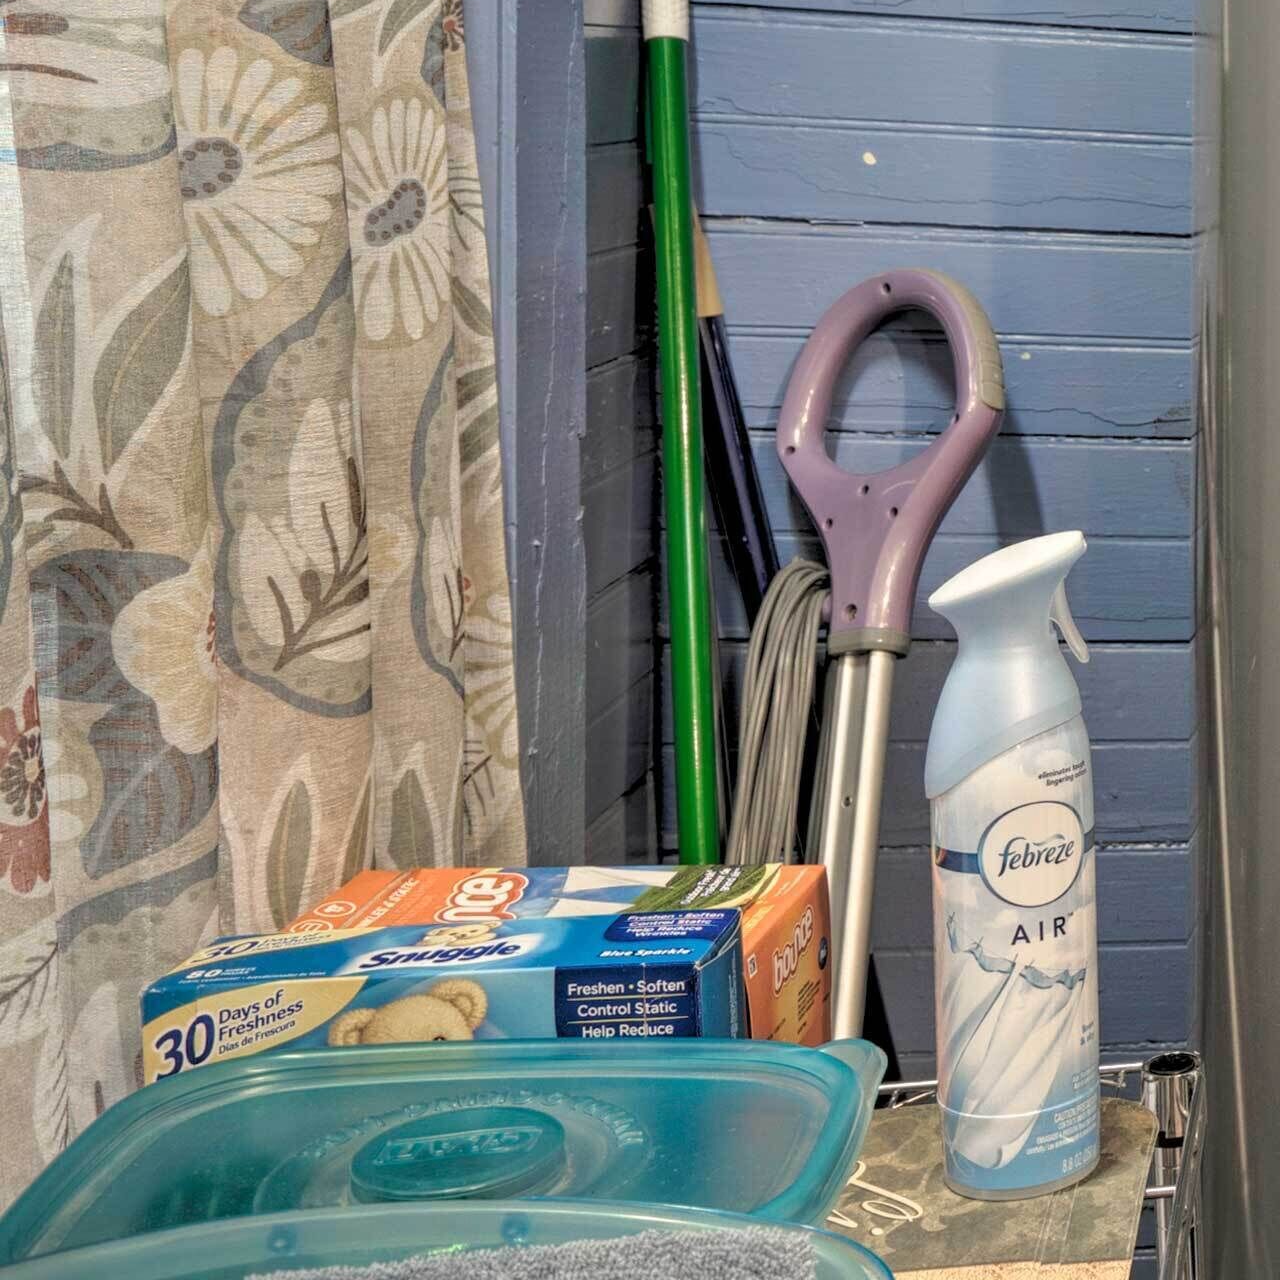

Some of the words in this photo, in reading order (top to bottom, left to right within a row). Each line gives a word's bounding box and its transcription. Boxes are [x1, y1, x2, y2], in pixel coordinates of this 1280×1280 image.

[998, 836, 1075, 877] febreze
[443, 876, 514, 920] nce
[627, 913, 674, 921] Freshen
[1010, 915, 1067, 946] AIR
[635, 930, 688, 938] Wrinkles
[191, 940, 260, 963] 30
[359, 941, 521, 969] Snuggle
[599, 949, 633, 958] Blue
[635, 948, 691, 957] Sparkle
[773, 907, 815, 996] bounce
[567, 982, 624, 996] Freshen
[636, 980, 686, 993] Soften
[217, 999, 304, 1042] Freshness
[577, 1003, 631, 1017] Control
[634, 1001, 678, 1015] Static
[154, 1013, 216, 1081] 30
[217, 1001, 260, 1025] Days
[264, 988, 284, 1007] of
[241, 1035, 254, 1047] de
[254, 1019, 296, 1043] Frescura
[582, 1024, 616, 1038] Help
[619, 1023, 674, 1036] Reduce
